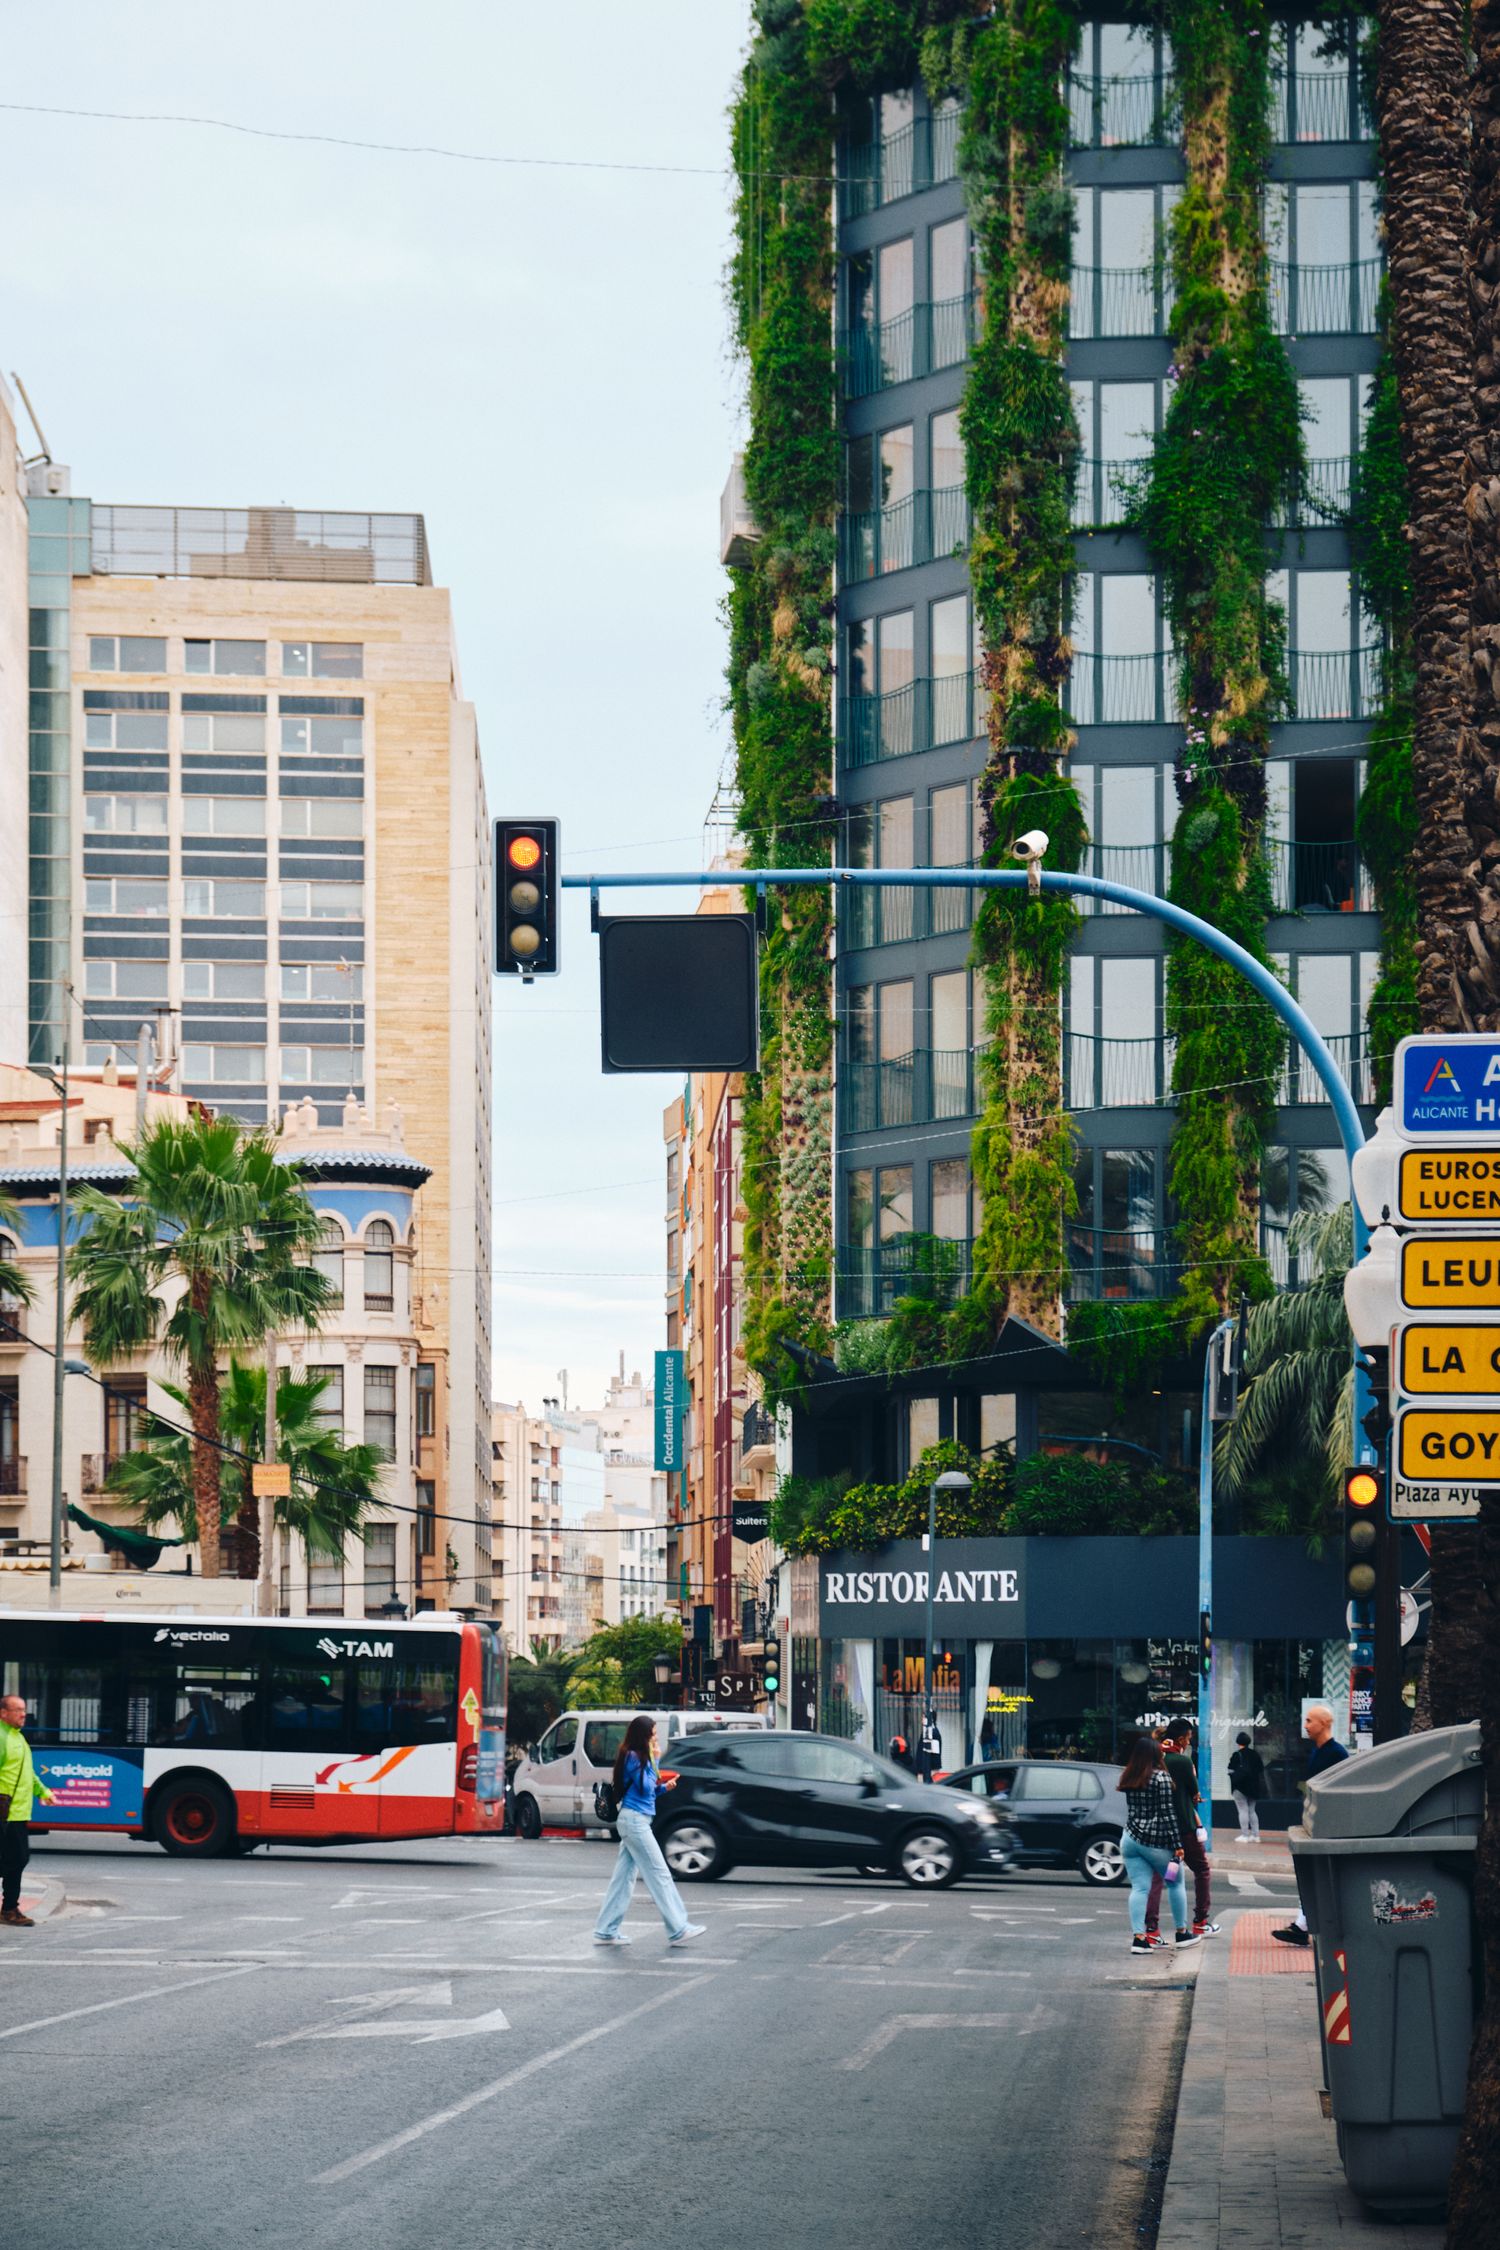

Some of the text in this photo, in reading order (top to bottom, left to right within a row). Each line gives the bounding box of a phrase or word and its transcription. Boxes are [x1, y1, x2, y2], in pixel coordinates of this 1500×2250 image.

[1412, 1106, 1469, 1119] ALICANTE
[1476, 1098, 1500, 1121] H
[1422, 1259, 1500, 1287] LEU
[1422, 1346, 1466, 1373] LA
[663, 1356, 675, 1465] Occidental Alicante
[1421, 1431, 1500, 1460] GOY
[1395, 1482, 1440, 1503] Plaza
[735, 1516, 768, 1526] Suiters
[825, 1570, 1019, 1604] RISTORANTE
[170, 1631, 230, 1642] vectalia
[342, 1641, 394, 1658] TAM
[50, 1763, 113, 1778] quickgold
